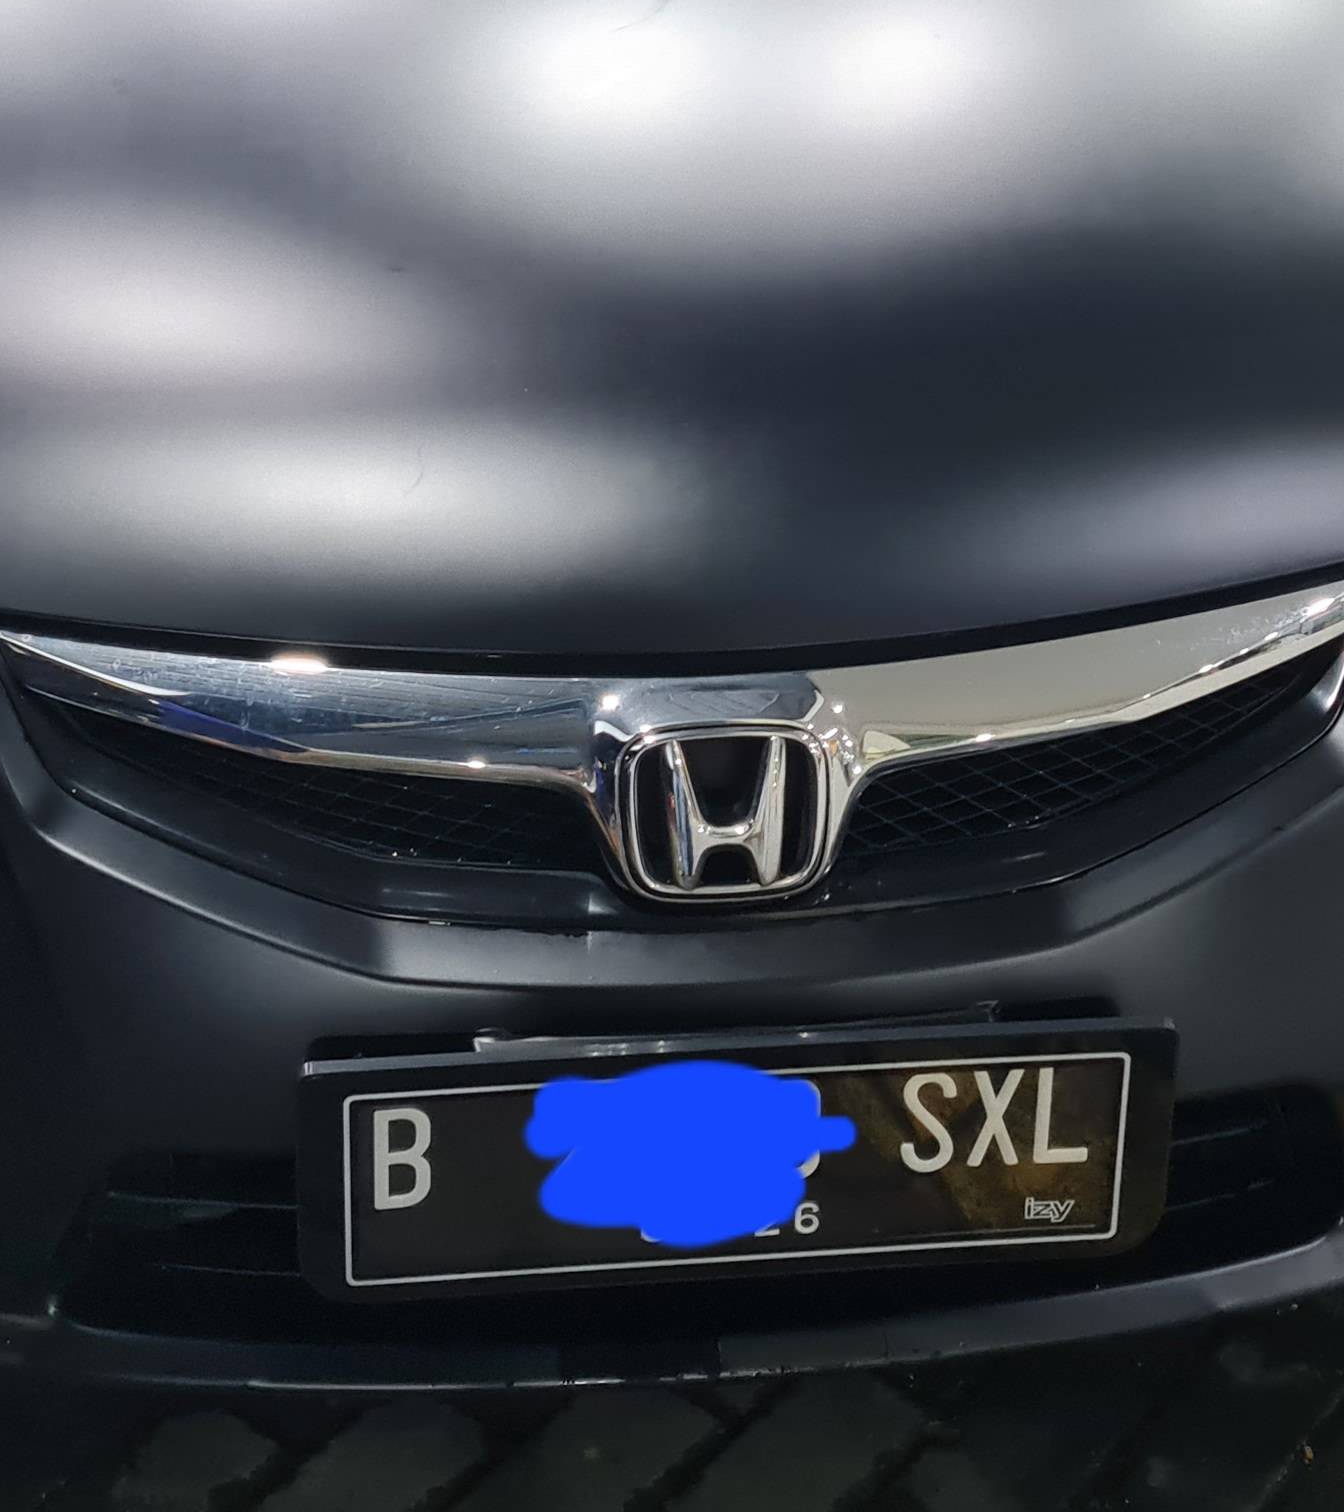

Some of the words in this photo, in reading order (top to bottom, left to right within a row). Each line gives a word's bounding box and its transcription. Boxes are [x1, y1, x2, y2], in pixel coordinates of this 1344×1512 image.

[371, 1107, 432, 1212] B
[900, 1066, 1089, 1174] SXL
[1023, 1196, 1075, 1223] izy
